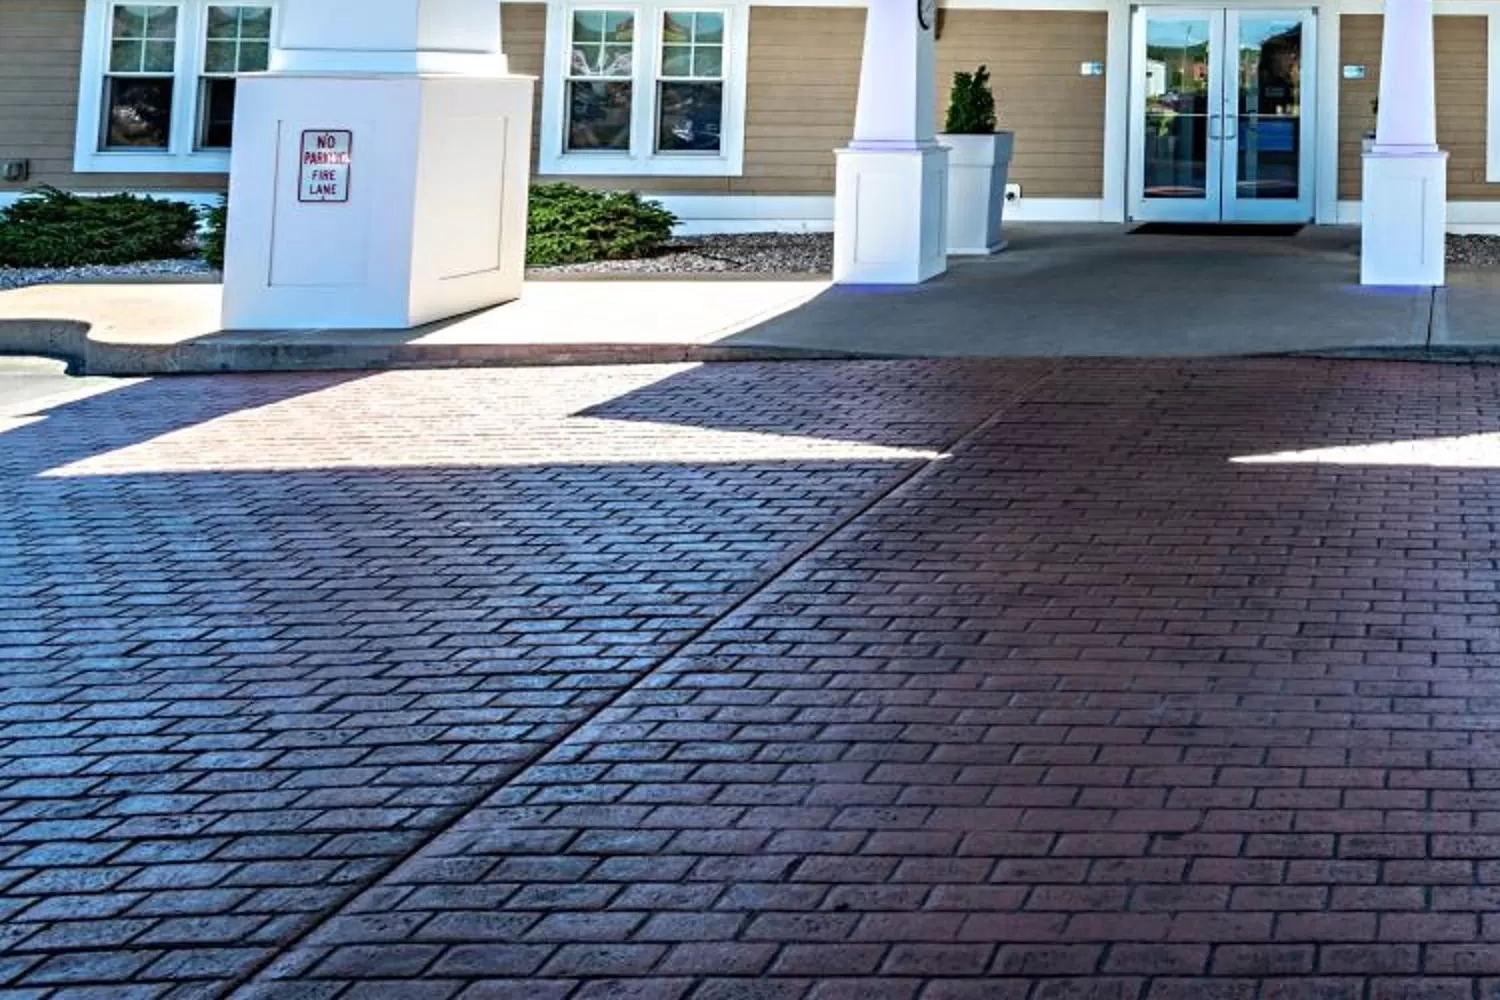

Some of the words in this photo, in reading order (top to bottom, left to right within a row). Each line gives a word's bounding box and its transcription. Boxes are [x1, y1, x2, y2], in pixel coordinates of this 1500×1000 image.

[317, 135, 336, 149] NO
[311, 169, 337, 181] FIRE
[308, 183, 337, 195] LANE
